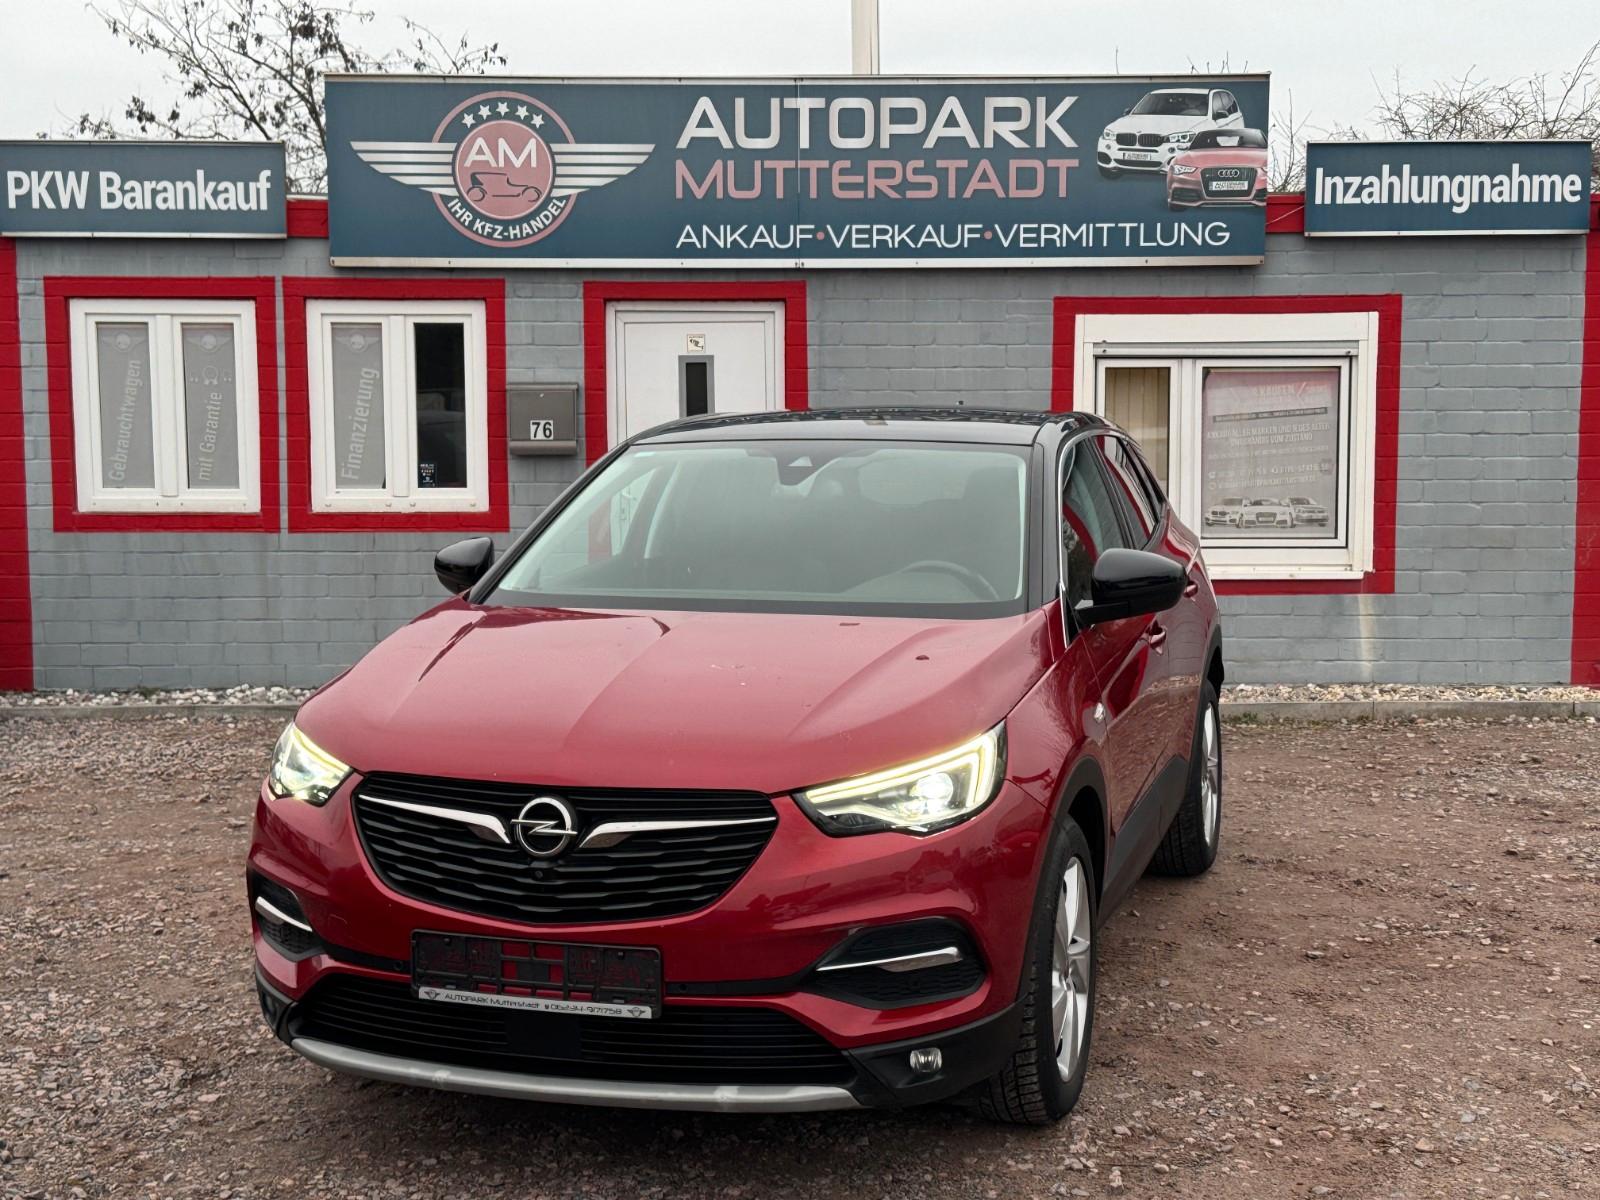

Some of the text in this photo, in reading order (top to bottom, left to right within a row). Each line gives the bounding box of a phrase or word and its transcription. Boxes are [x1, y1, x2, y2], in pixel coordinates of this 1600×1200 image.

[676, 95, 1079, 150] AUTOPARK
[464, 137, 537, 168] AM
[6, 169, 271, 211] PKW Barankauf
[675, 157, 1080, 201] MUTTERSTADT
[1315, 163, 1582, 214] Inzahlungnahme
[447, 198, 567, 240] IHR KFZ-HANDEL
[107, 359, 144, 482] Gebrauchtwagen
[197, 391, 224, 481] mit Garantie
[341, 367, 381, 481] Finanzierung
[532, 421, 553, 441] 76
[444, 992, 489, 1004] AUTOPARK
[490, 998, 539, 1009] Mutterstadt
